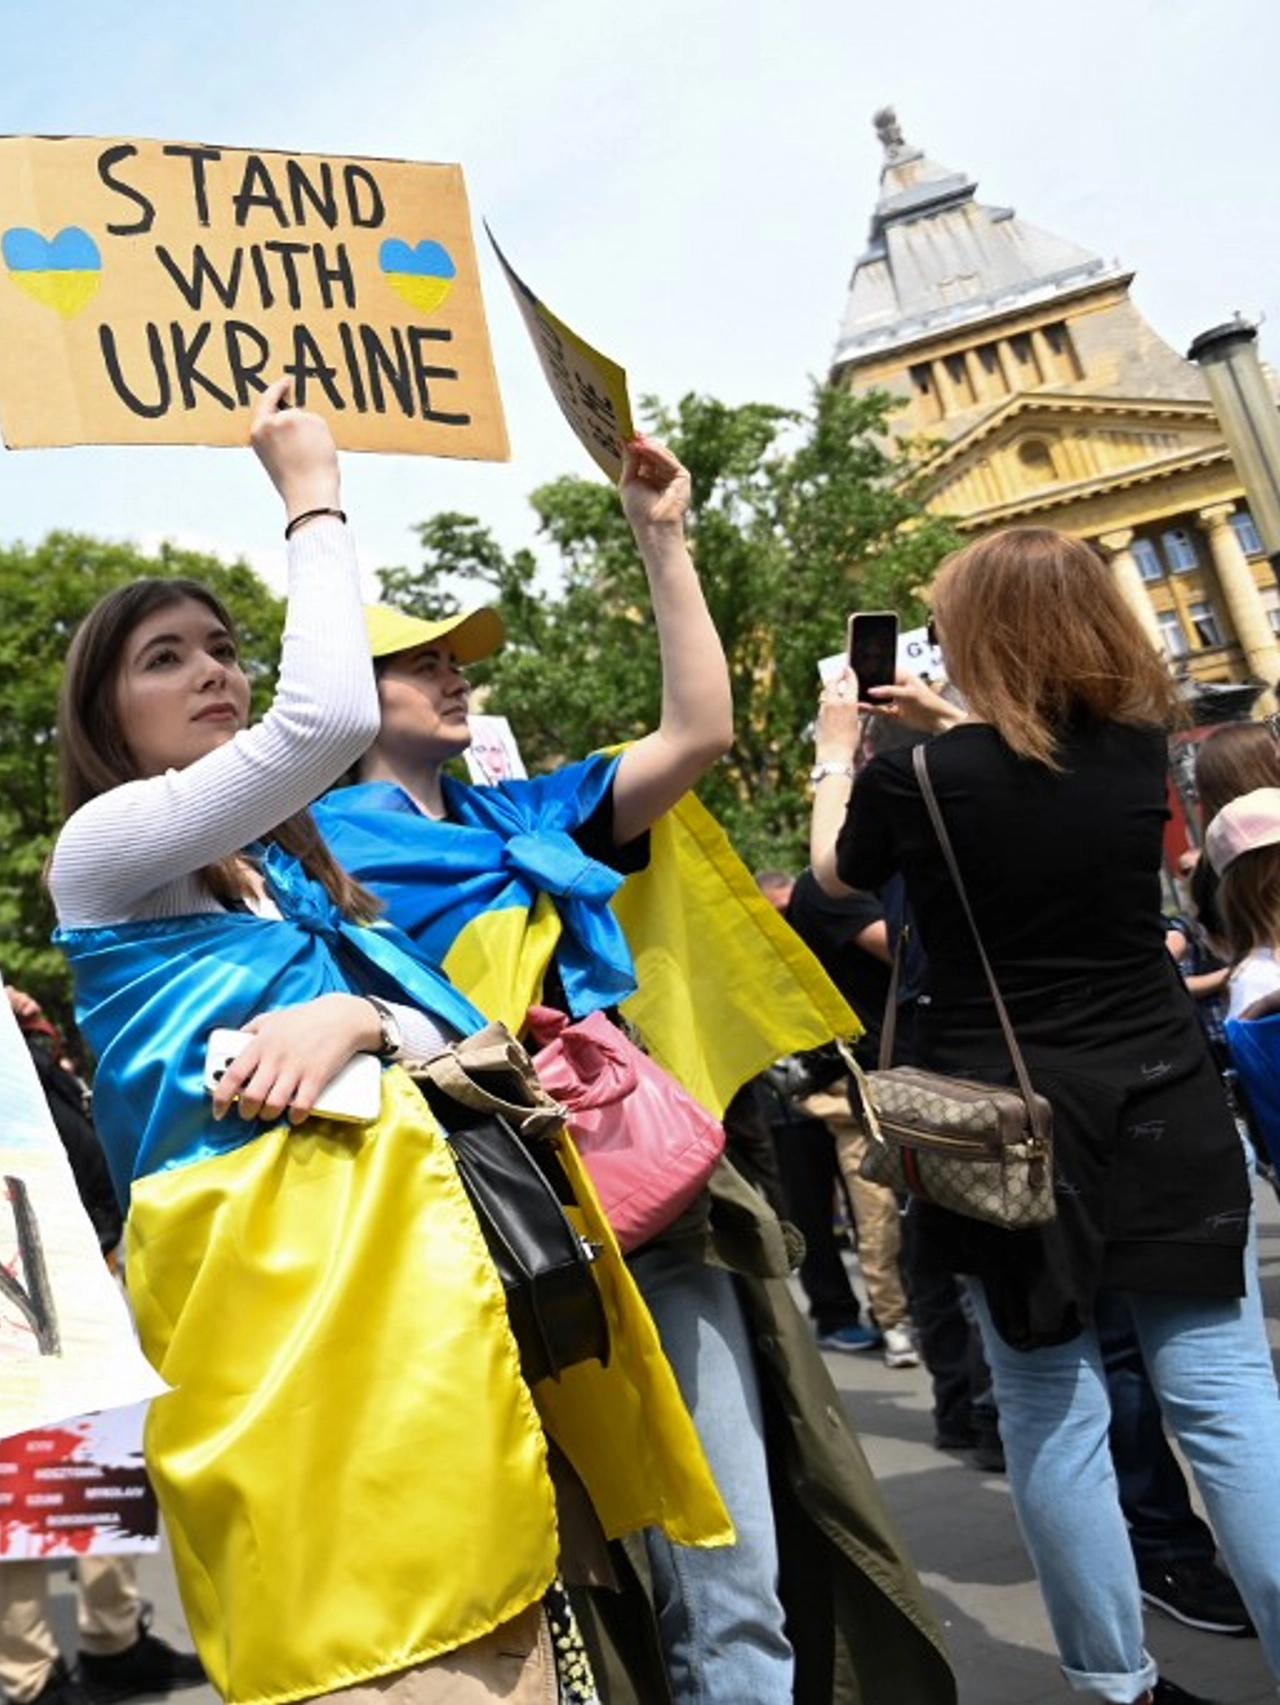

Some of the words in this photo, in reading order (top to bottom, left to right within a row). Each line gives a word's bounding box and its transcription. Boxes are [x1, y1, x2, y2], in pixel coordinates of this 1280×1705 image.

[97, 144, 387, 236] STAND
[155, 240, 358, 310] WITH
[98, 320, 471, 426] UKRAINE
